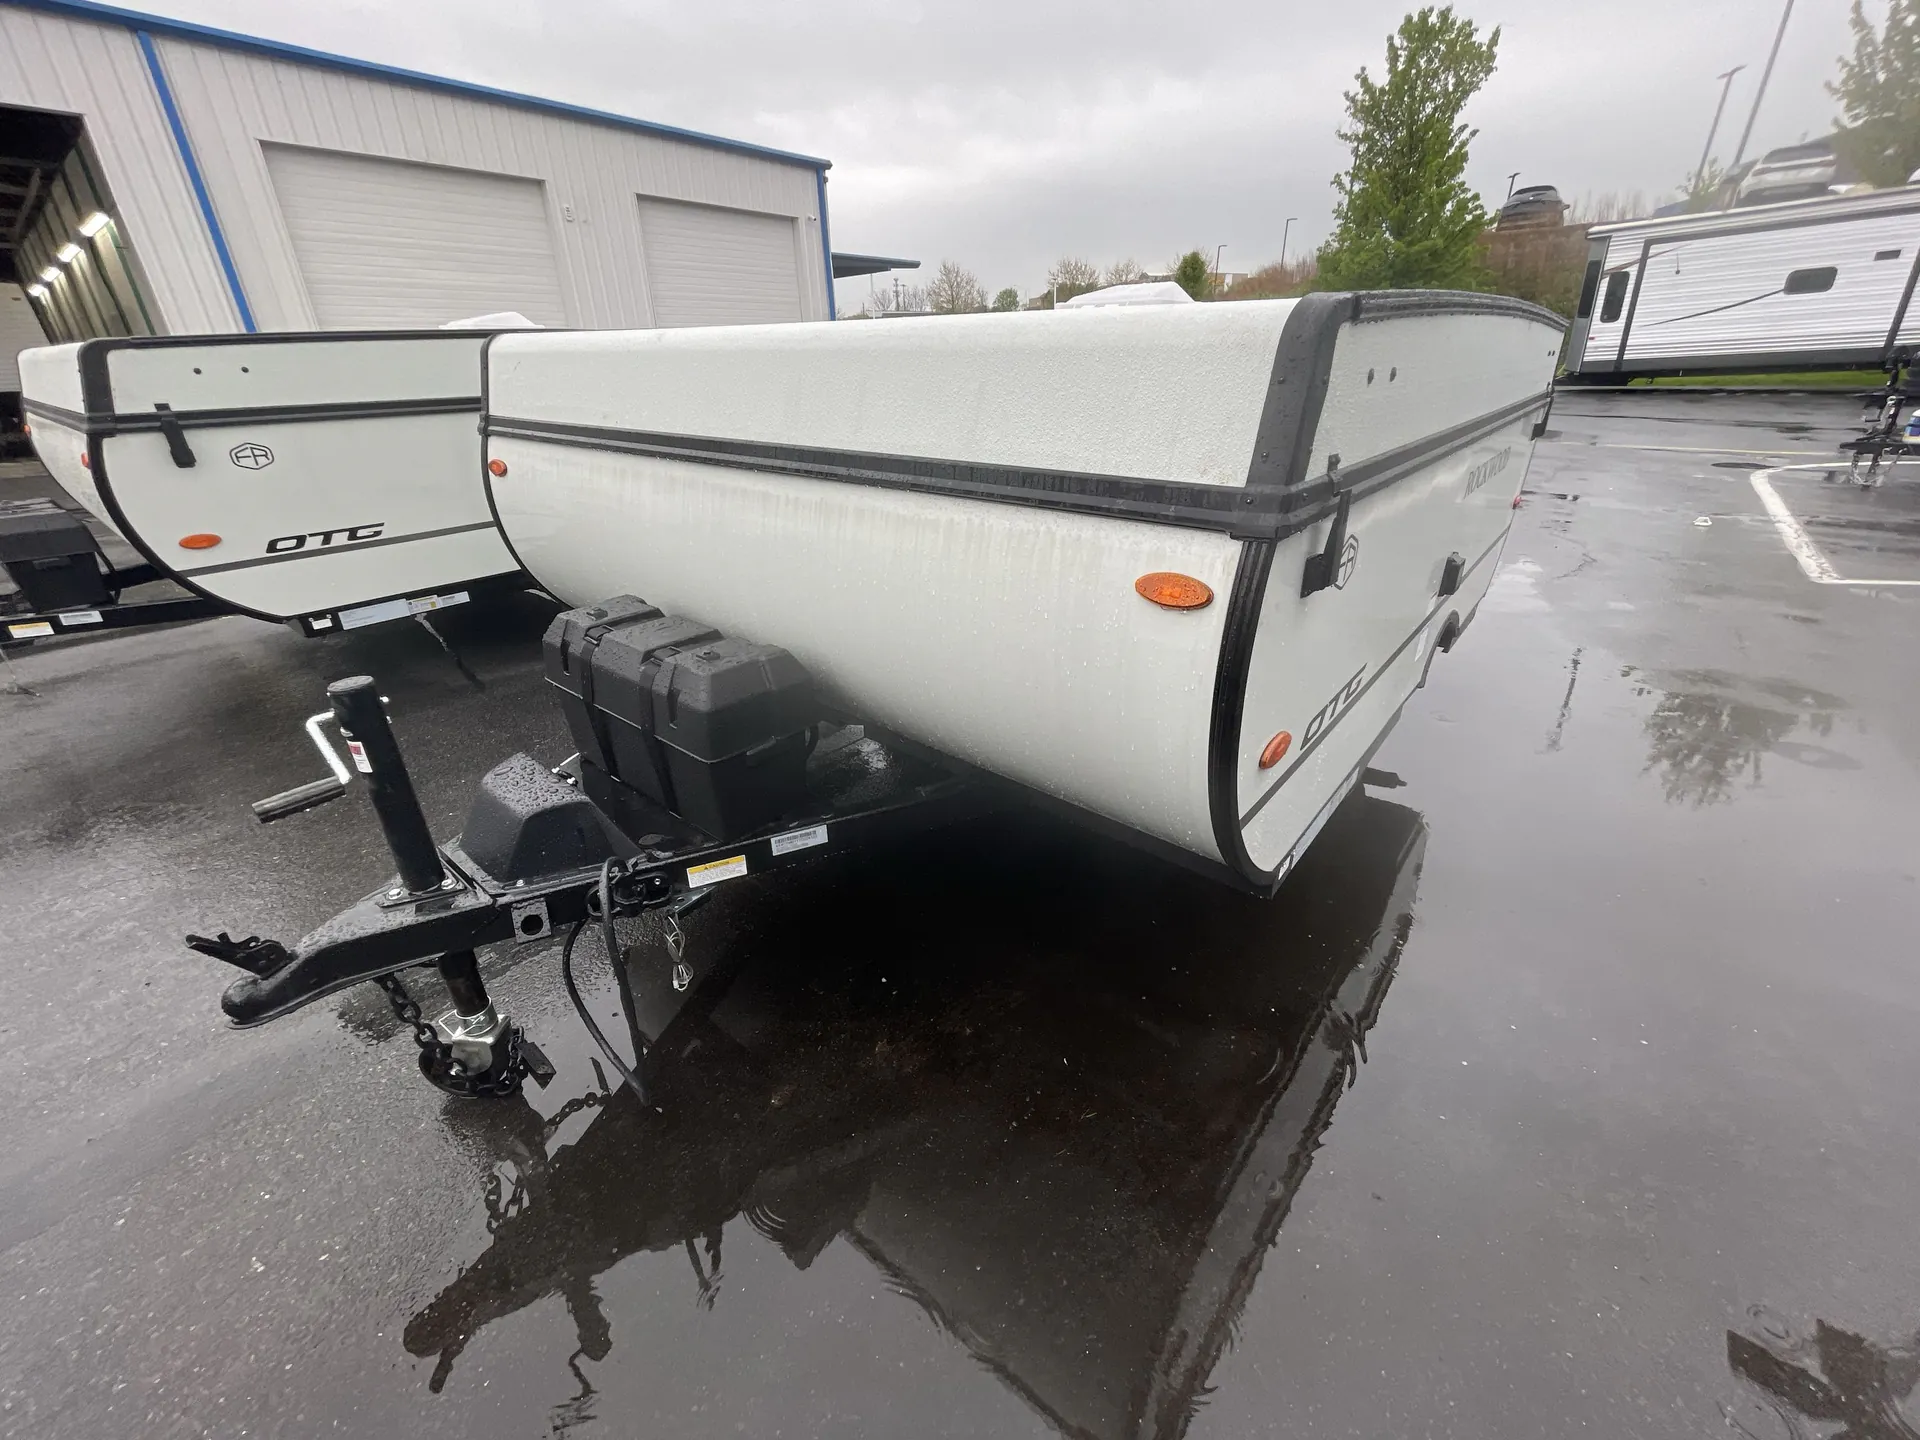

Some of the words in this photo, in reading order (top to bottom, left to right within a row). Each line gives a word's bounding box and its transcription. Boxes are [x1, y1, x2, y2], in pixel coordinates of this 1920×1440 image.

[233, 445, 271, 467] FR
[265, 522, 385, 554] OTG
[1300, 662, 1368, 751] OTG
